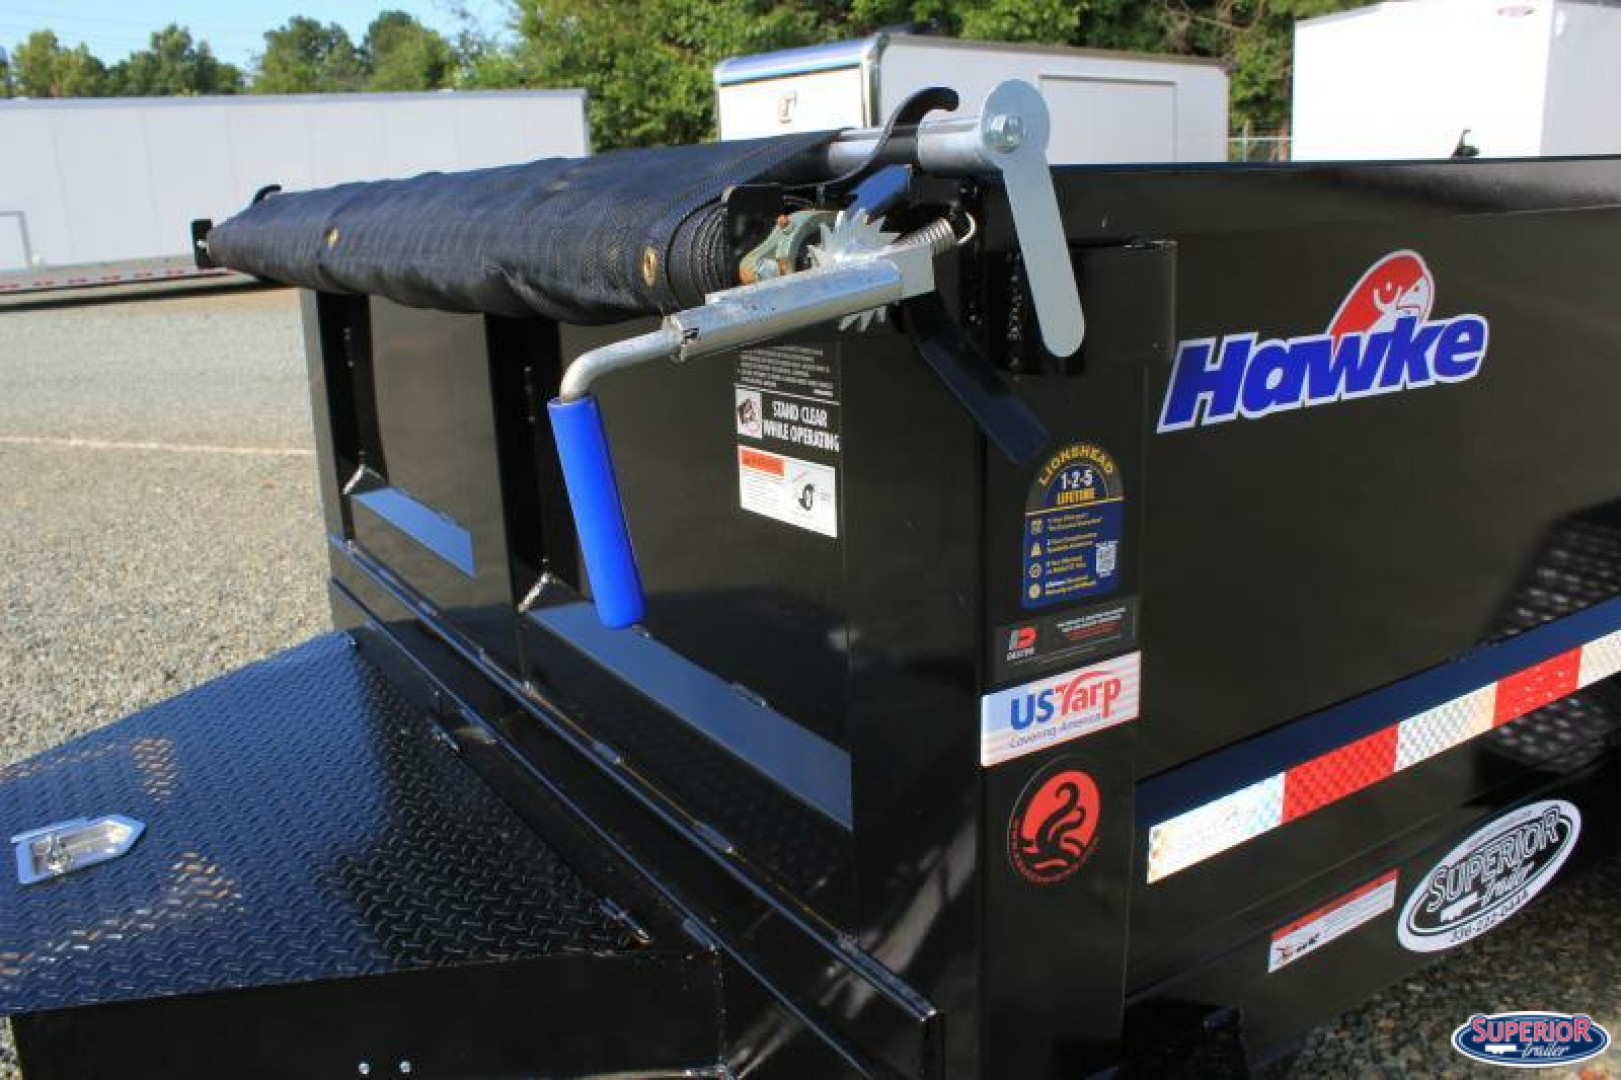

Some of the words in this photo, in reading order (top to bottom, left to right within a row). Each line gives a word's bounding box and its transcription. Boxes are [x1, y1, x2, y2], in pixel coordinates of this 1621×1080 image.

[1158, 314, 1488, 433] Hawke
[772, 400, 799, 422] STAND
[801, 406, 828, 428] CLEAR
[763, 419, 790, 440] WHILE
[790, 425, 840, 452] OPERATING
[1039, 445, 1113, 486] LIONSHEAD
[1426, 805, 1560, 913] SUPERIOR
